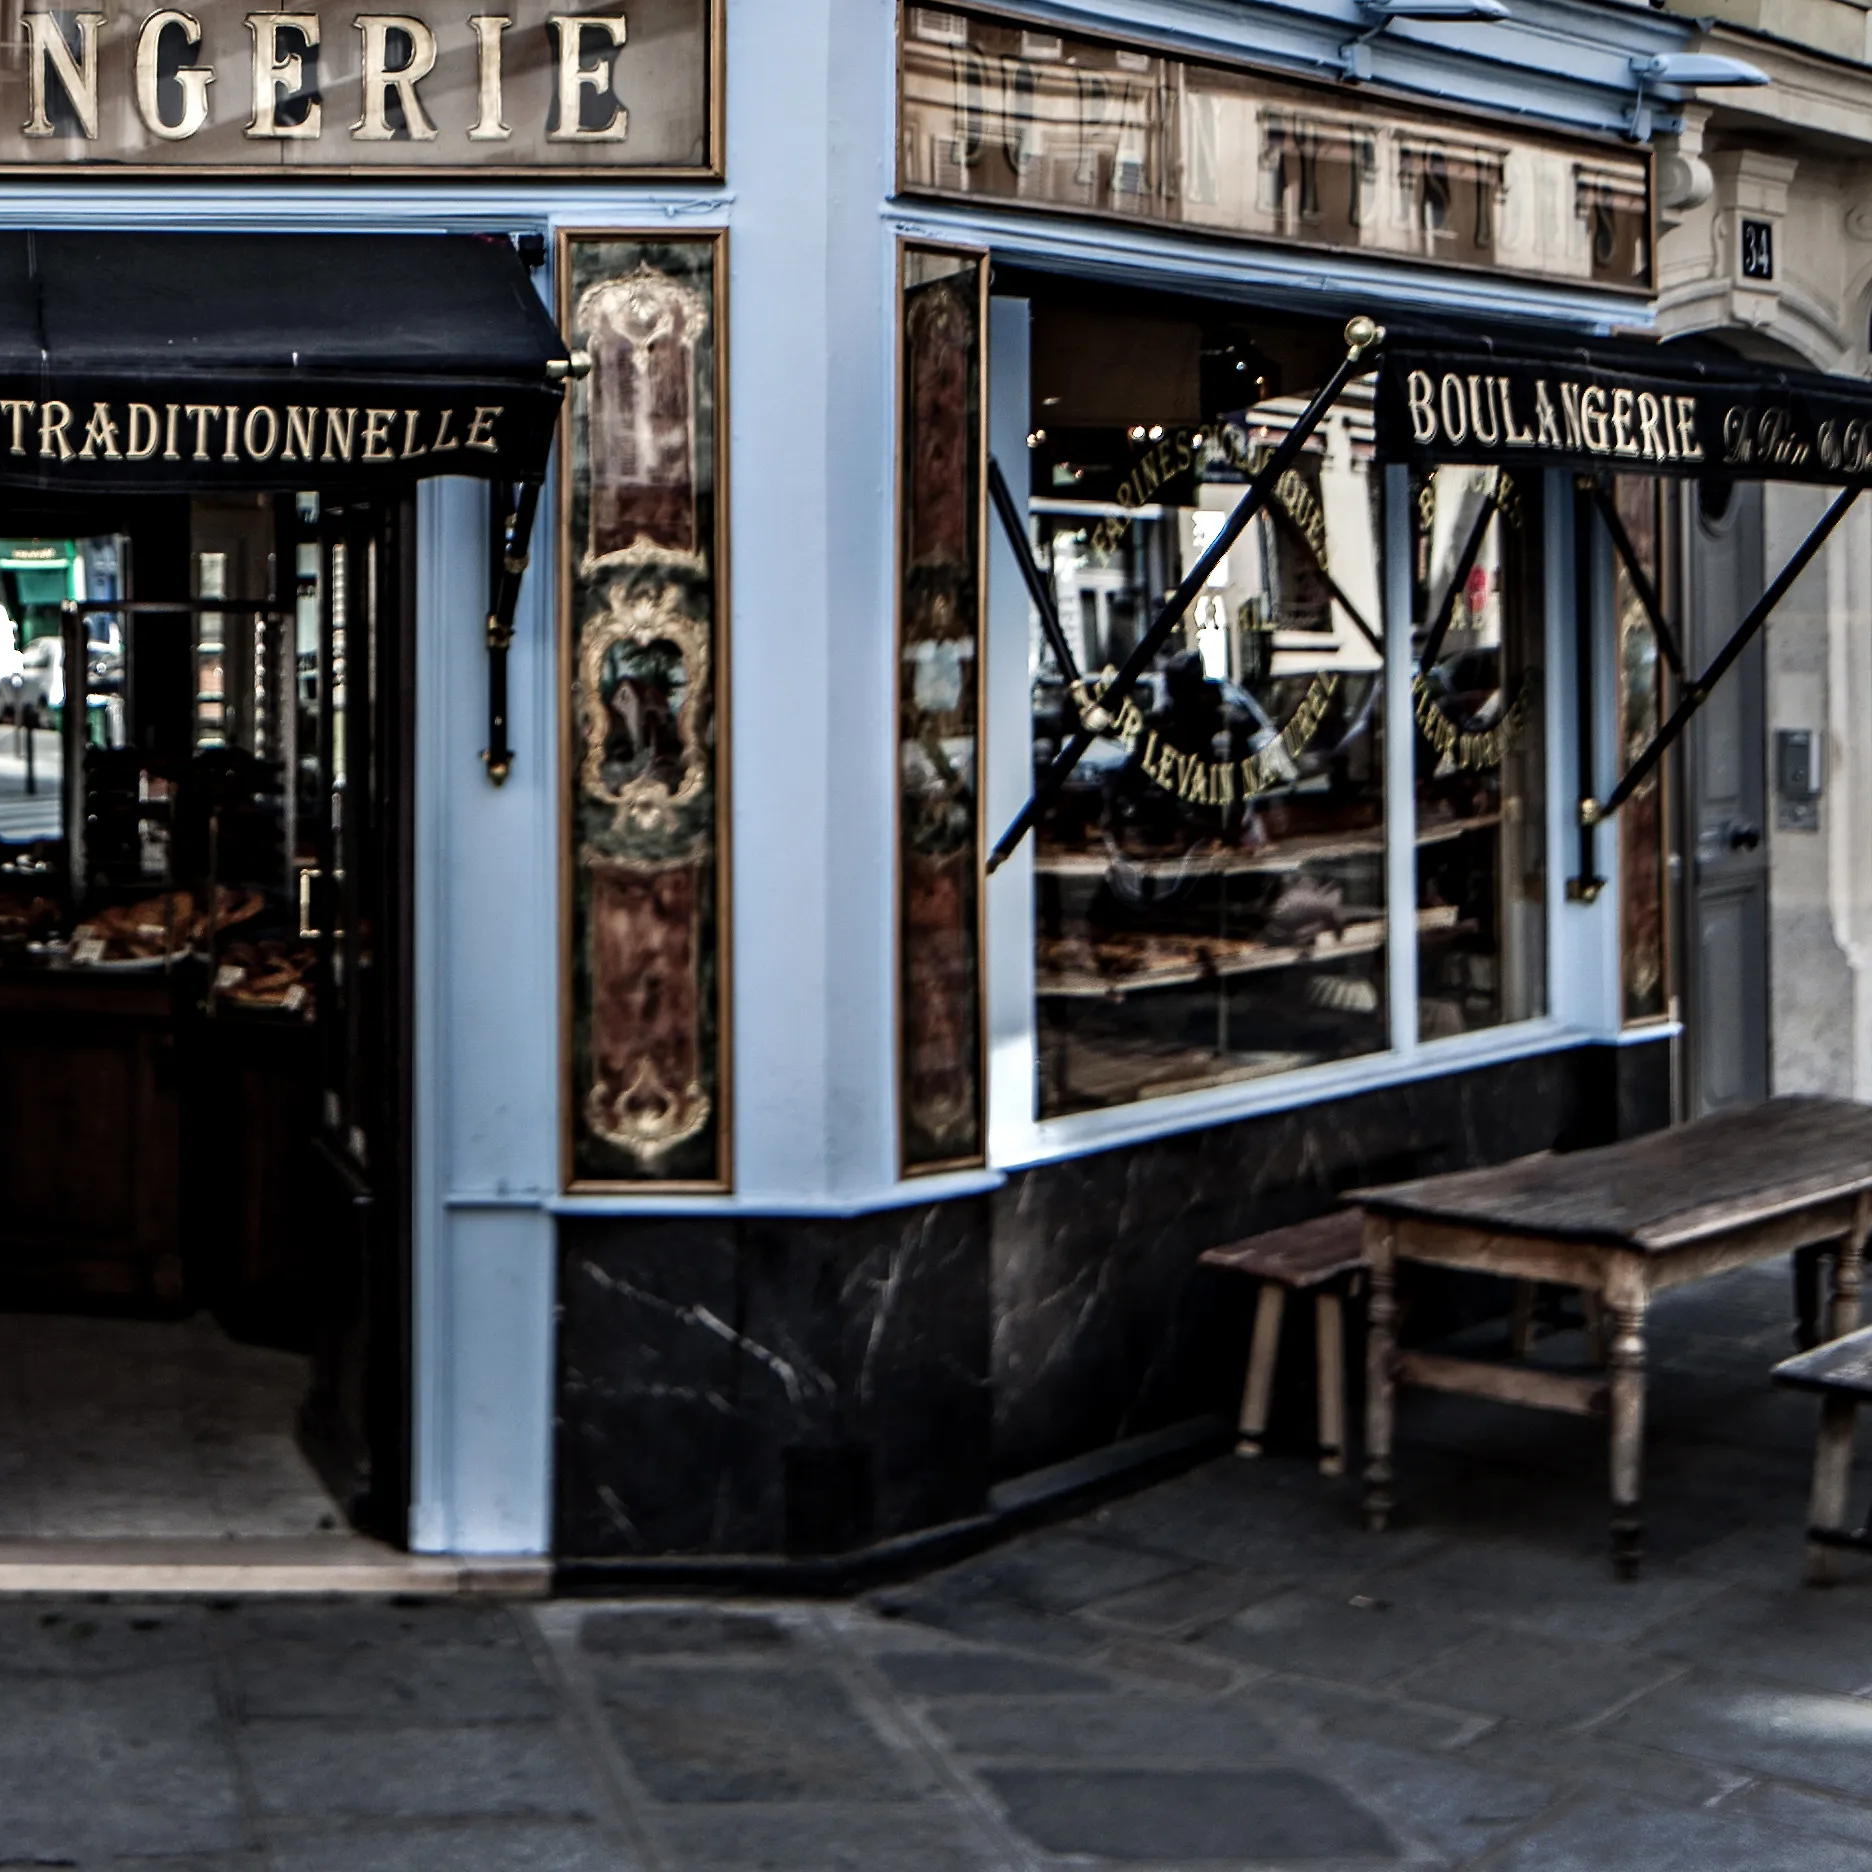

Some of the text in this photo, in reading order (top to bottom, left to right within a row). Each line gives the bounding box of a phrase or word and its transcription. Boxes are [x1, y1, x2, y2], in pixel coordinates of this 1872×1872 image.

[1743, 221, 1771, 278] 34
[0, 396, 505, 462] TRADITIONNELLE
[1408, 369, 1705, 463] BOULANGERIE
[1139, 729, 1236, 807] LEVAIN
